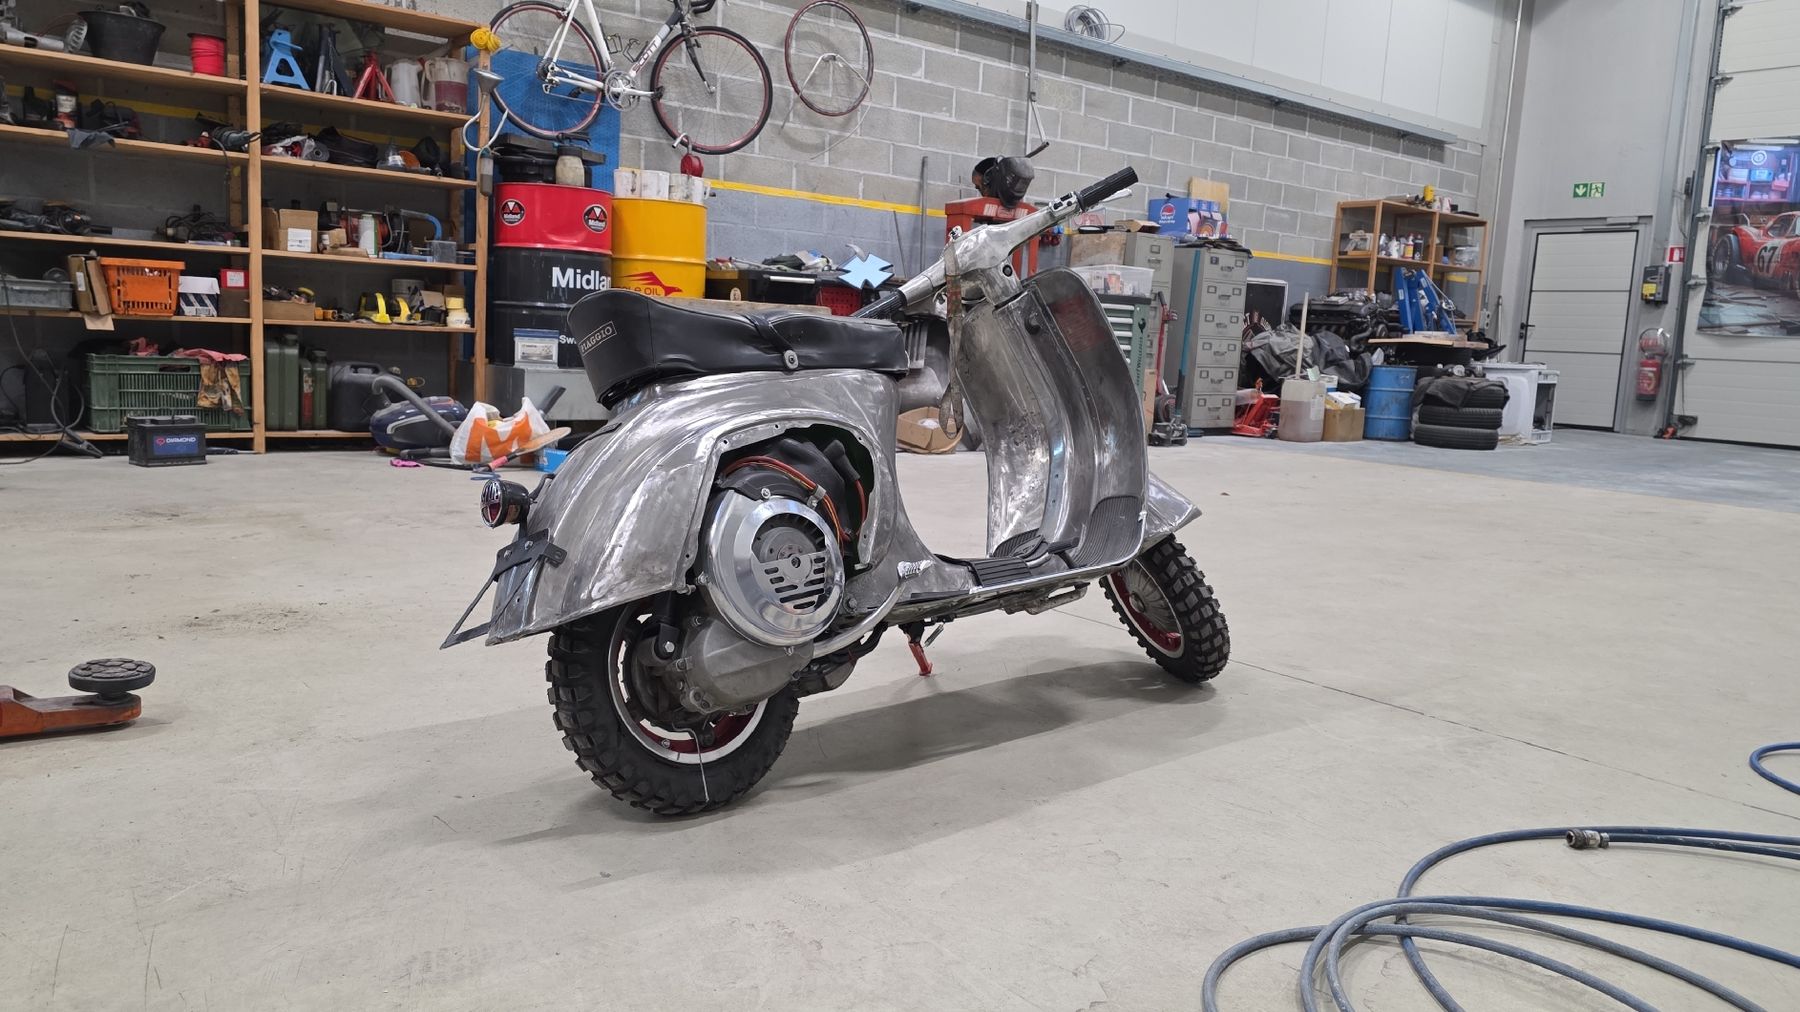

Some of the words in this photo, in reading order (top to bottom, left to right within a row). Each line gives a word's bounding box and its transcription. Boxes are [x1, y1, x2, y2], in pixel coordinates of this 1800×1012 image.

[1757, 245, 1778, 274] 67
[644, 287, 661, 296] OIL
[559, 334, 577, 345] Sw
[165, 436, 197, 444] DIAMOND
